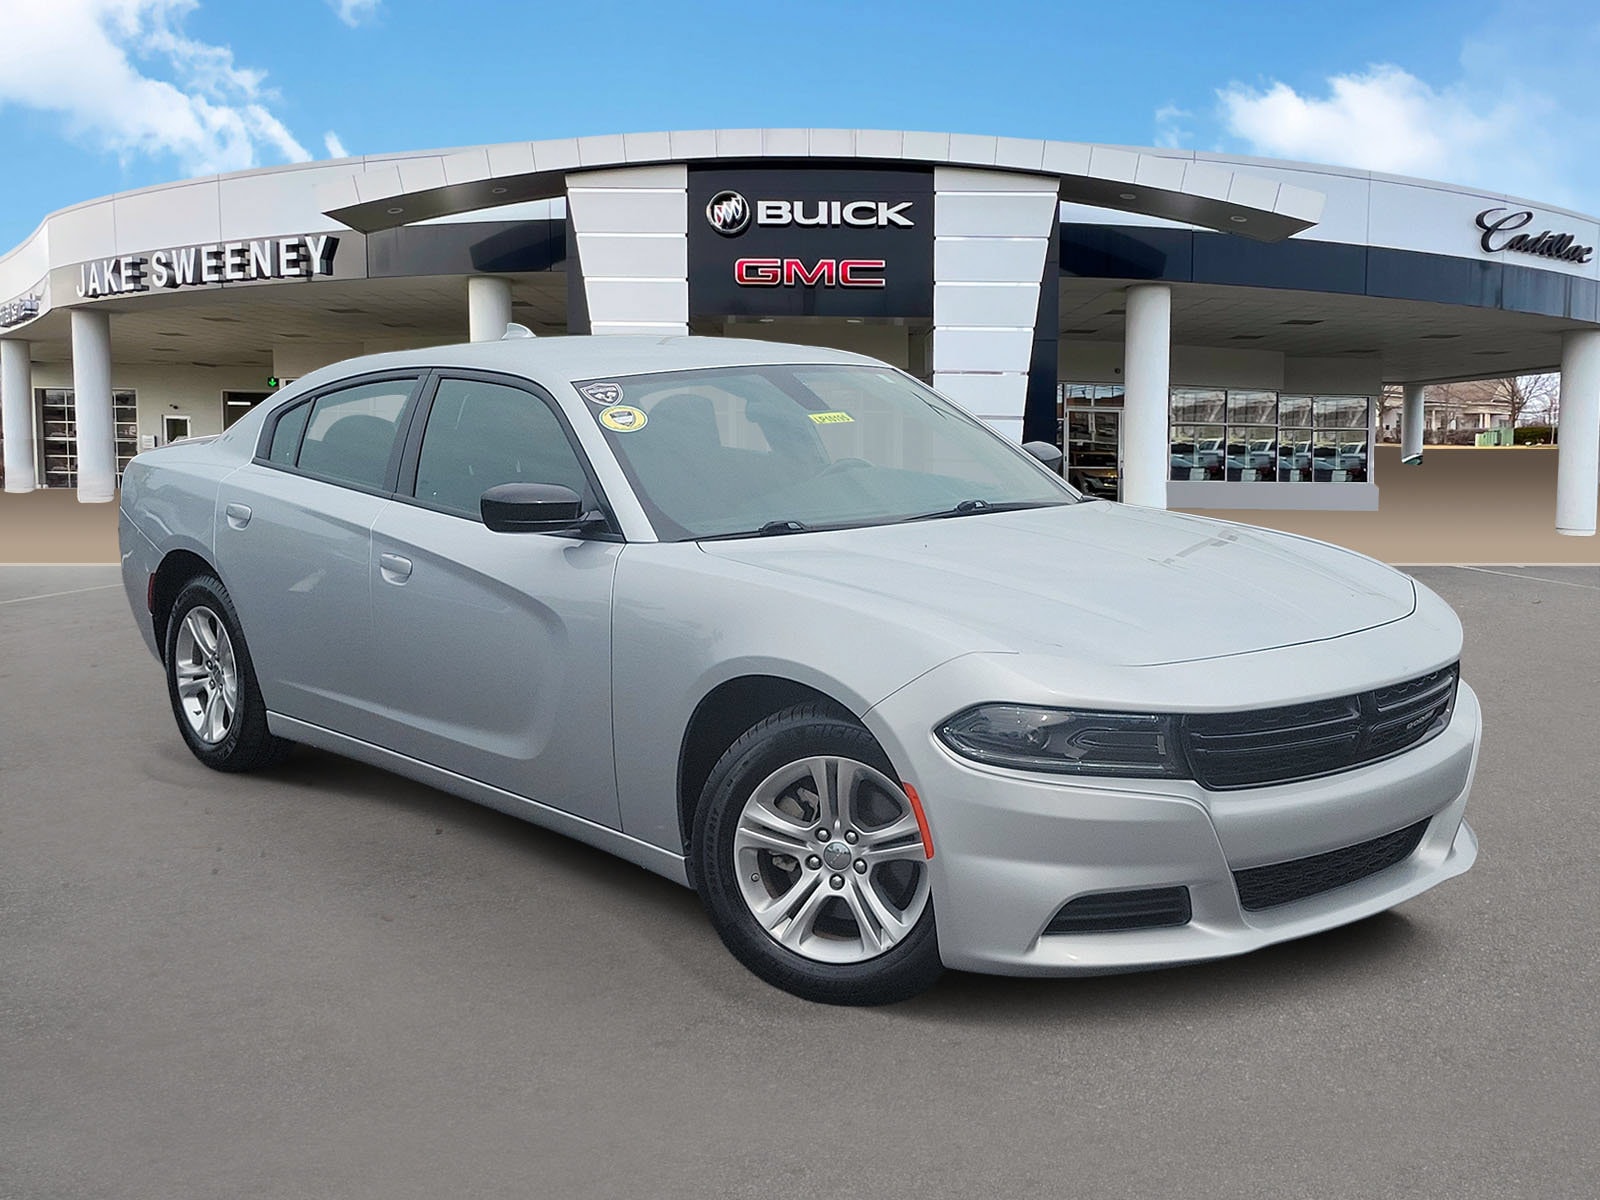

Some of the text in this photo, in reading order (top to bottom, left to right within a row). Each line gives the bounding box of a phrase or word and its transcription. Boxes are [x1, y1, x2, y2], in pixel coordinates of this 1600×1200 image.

[757, 200, 915, 226] BUICK
[1475, 207, 1594, 264] Cadillac
[76, 234, 332, 298] JAKE SWEENEY
[734, 258, 886, 287] GMC
